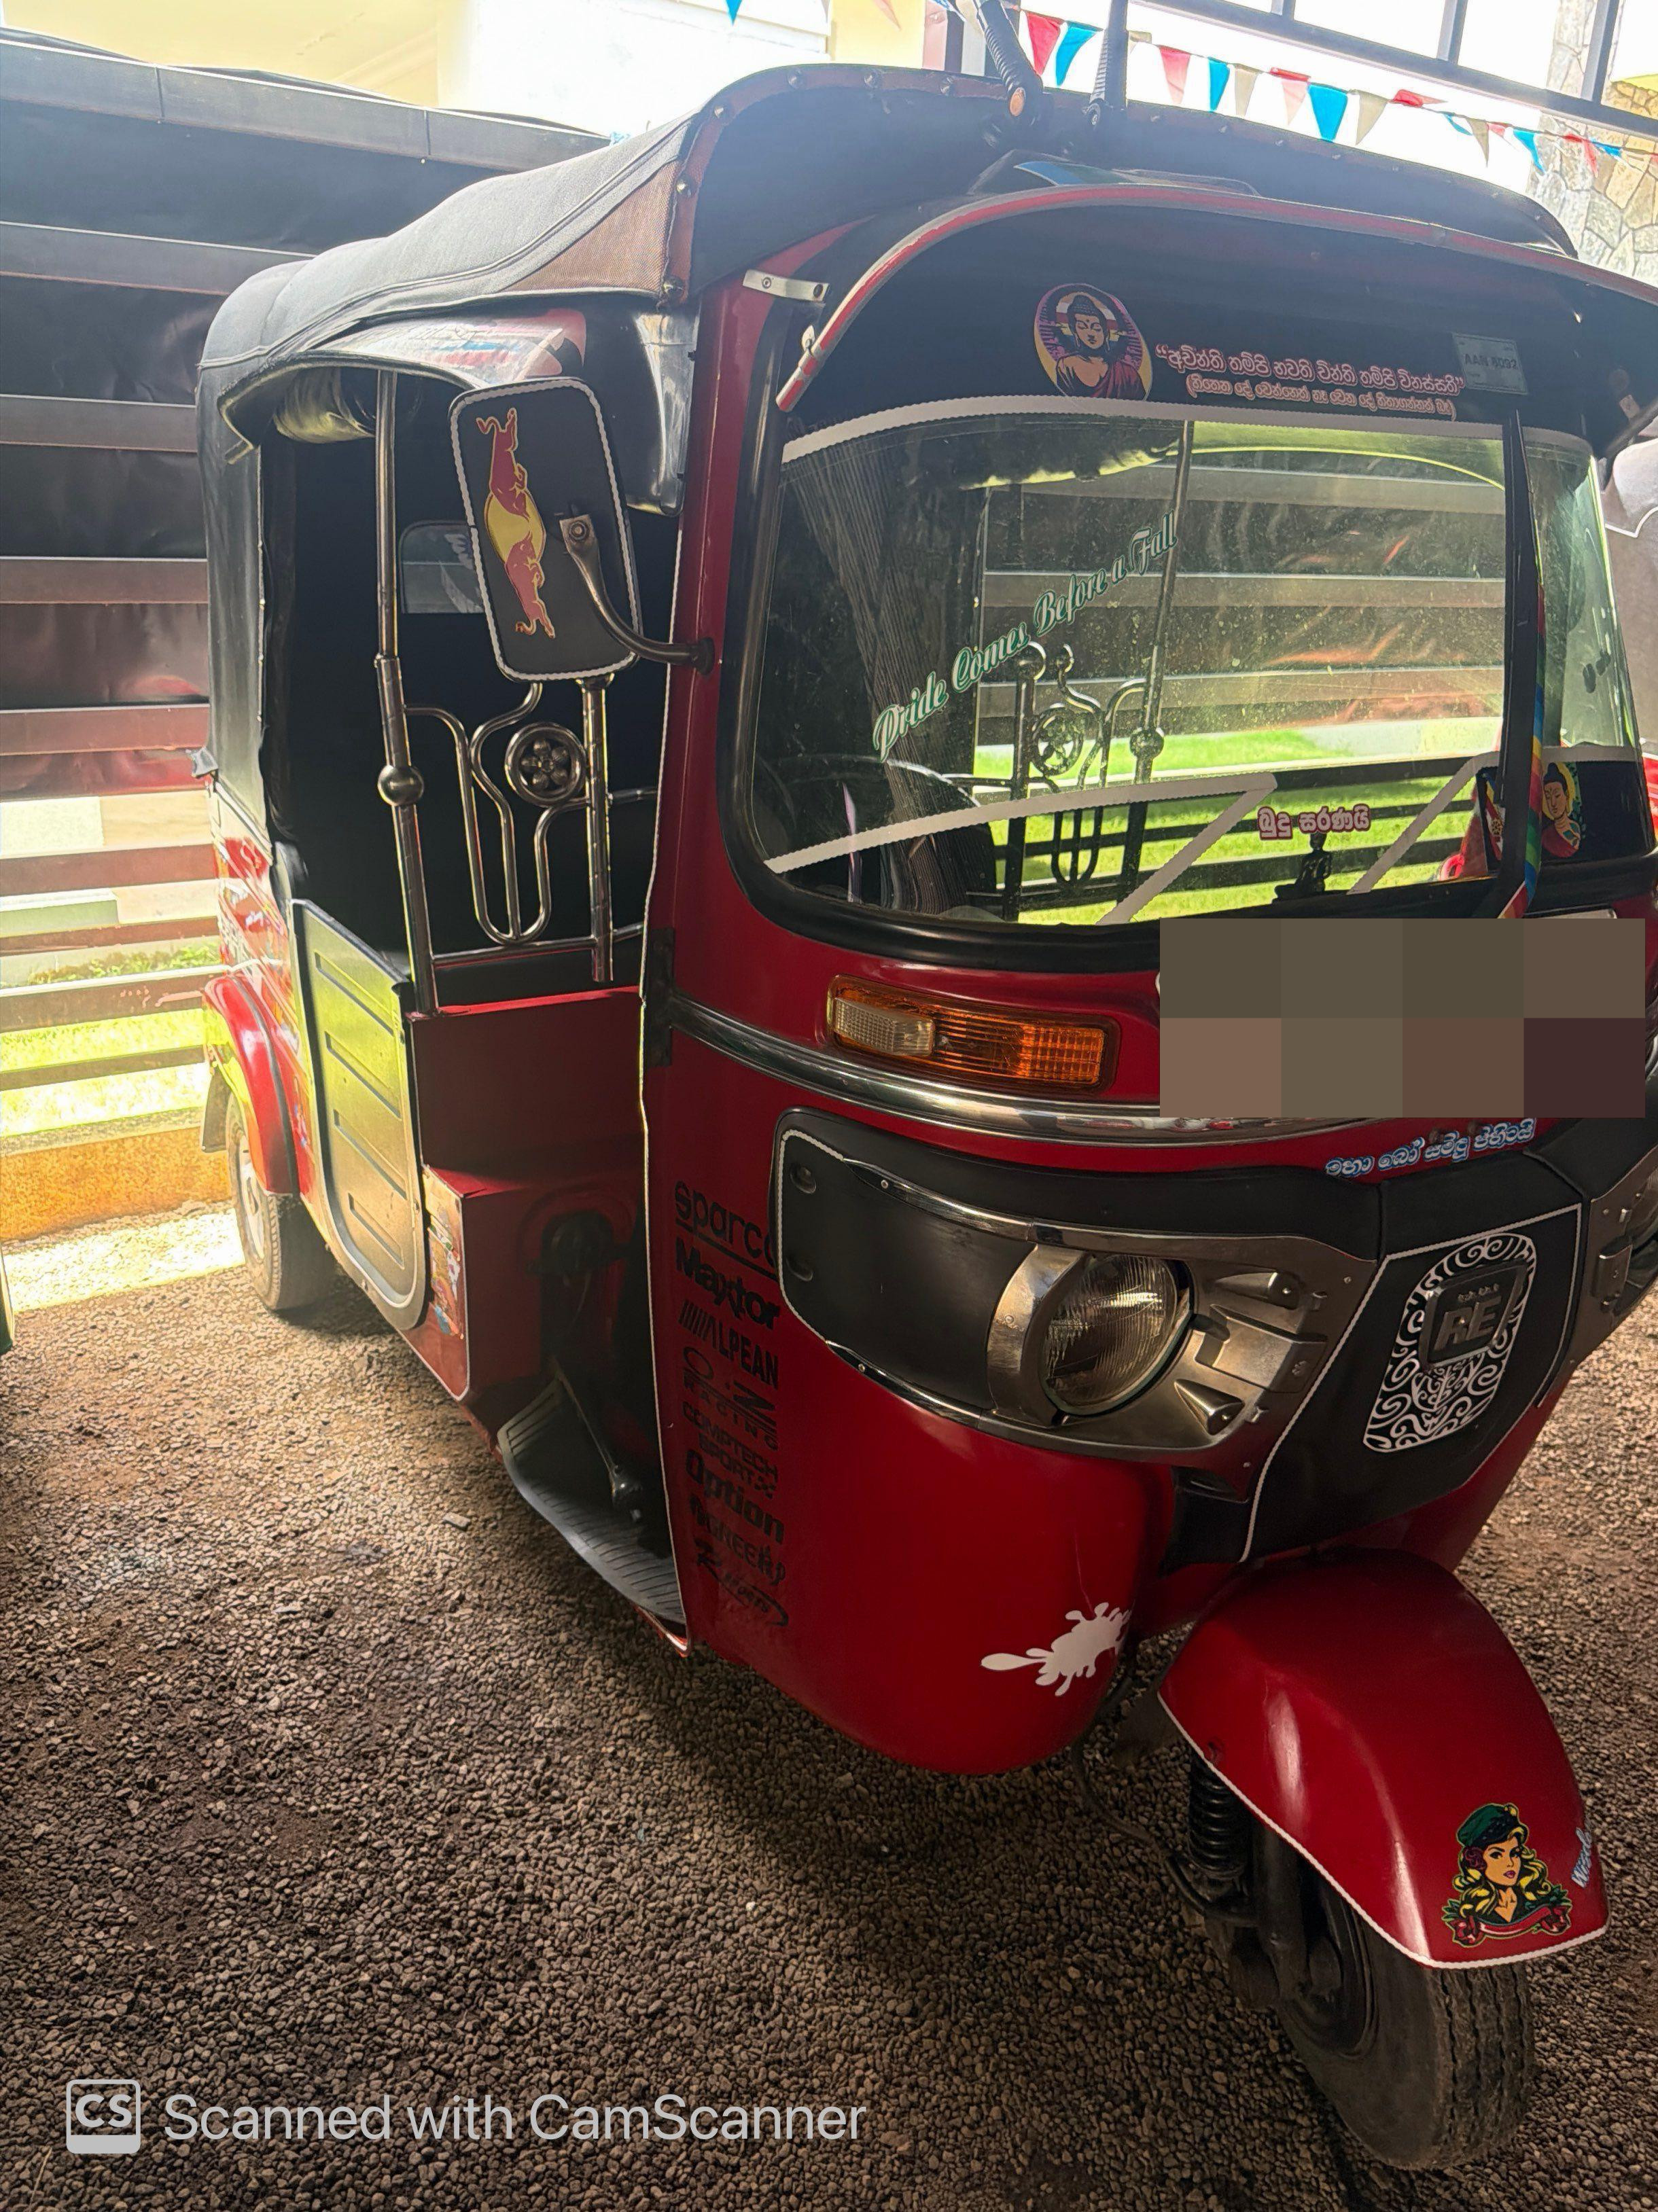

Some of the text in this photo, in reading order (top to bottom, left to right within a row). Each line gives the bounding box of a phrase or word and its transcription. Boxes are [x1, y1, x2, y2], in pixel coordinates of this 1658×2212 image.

[1033, 568, 1108, 637] Before
[1112, 554, 1127, 585] a
[1128, 510, 1178, 576] Fall
[1435, 1295, 1502, 1352] RE
